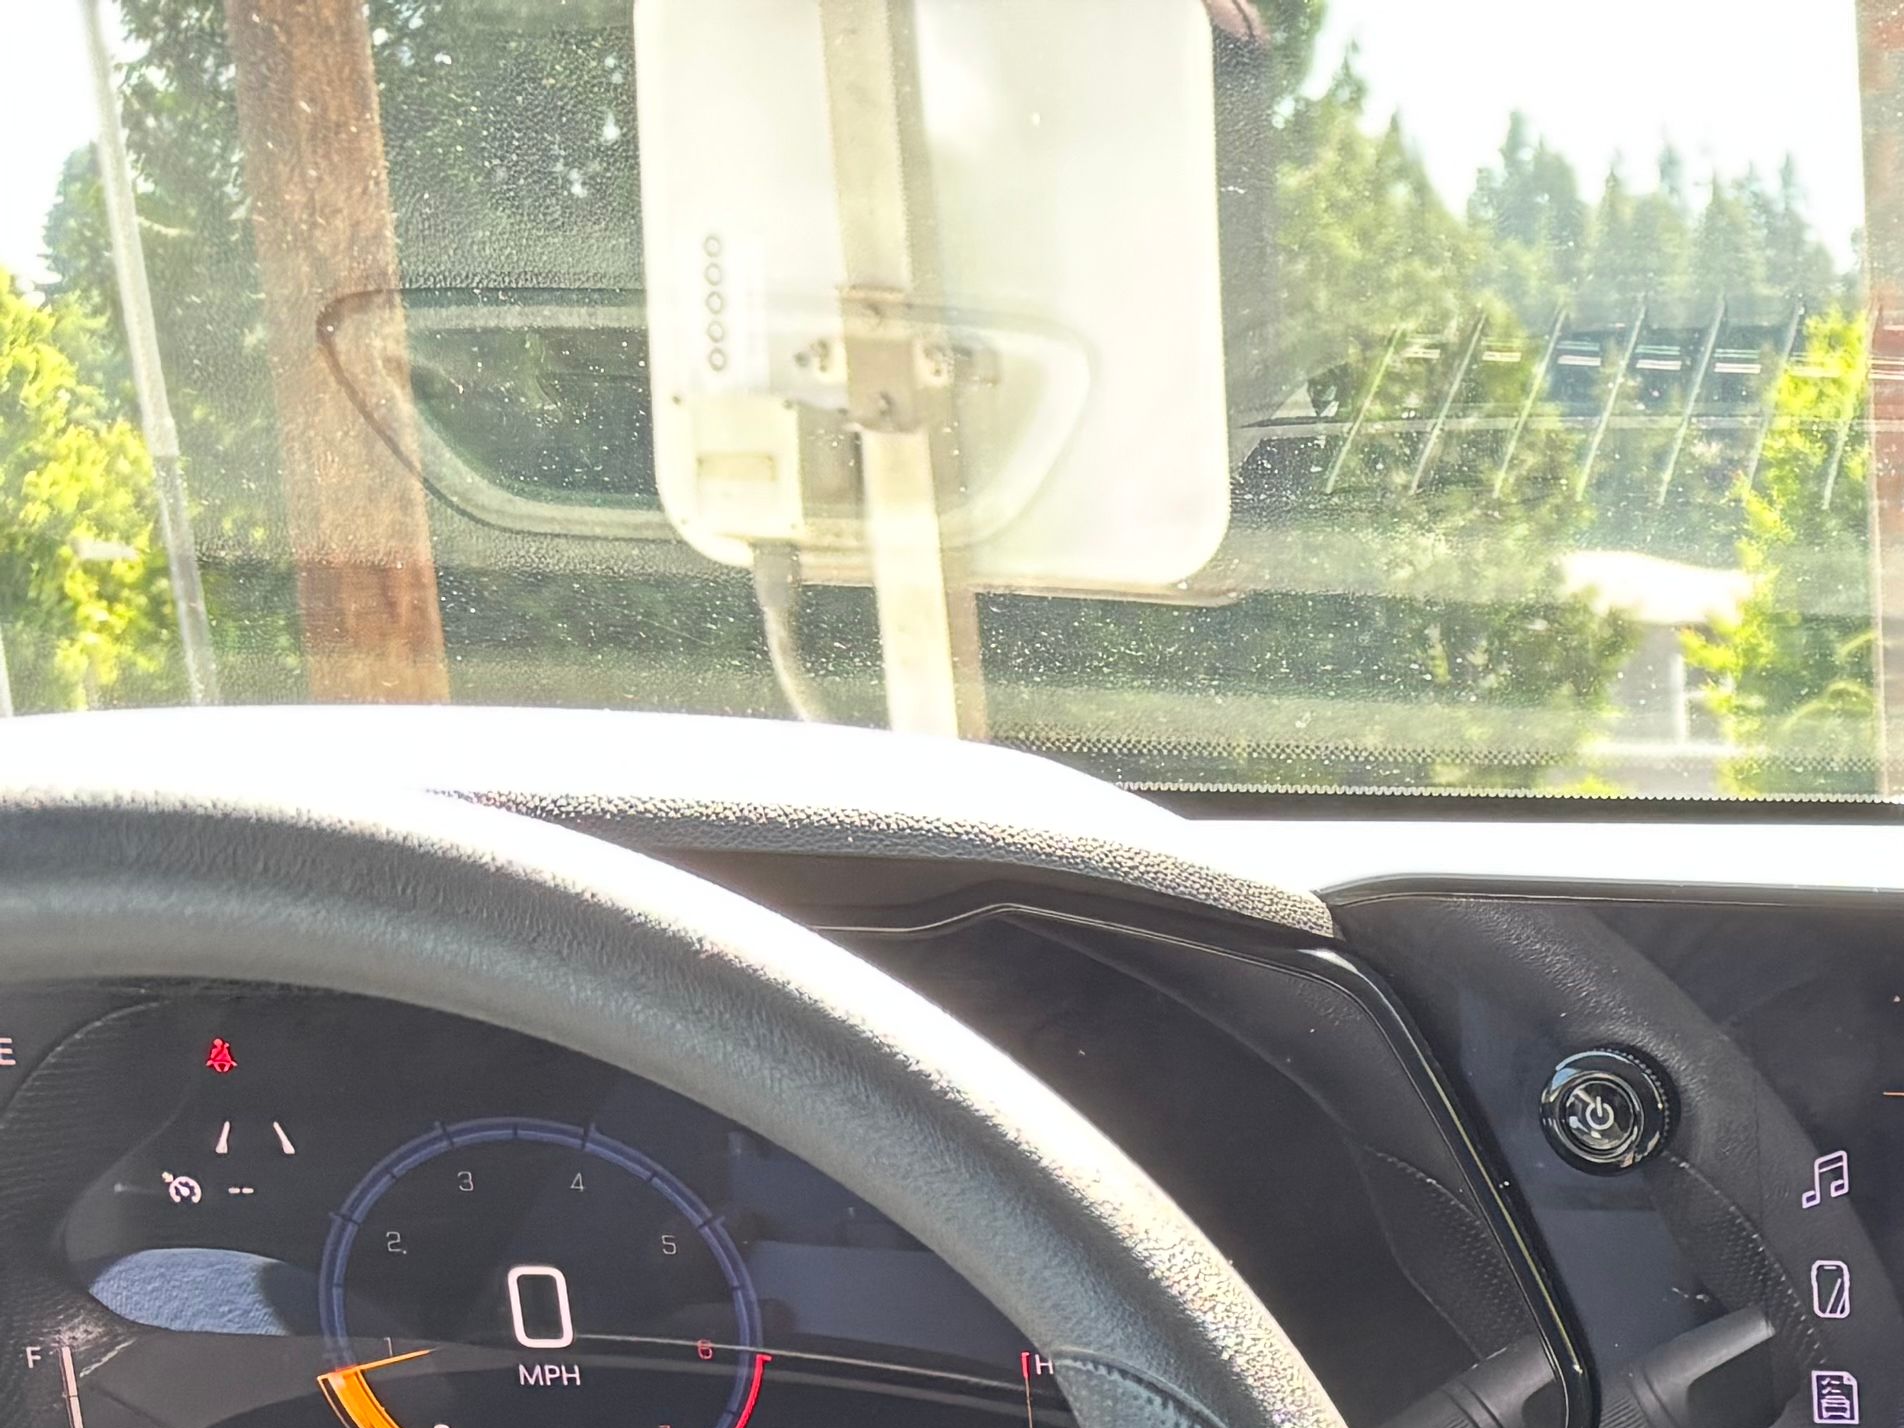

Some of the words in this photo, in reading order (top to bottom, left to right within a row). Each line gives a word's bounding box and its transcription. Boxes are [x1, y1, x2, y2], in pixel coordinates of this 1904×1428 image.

[458, 1171, 474, 1192] 3
[570, 1172, 585, 1192] 4
[386, 1231, 402, 1253] 2
[661, 1235, 677, 1256] 5
[507, 1265, 574, 1349] 0
[26, 1346, 43, 1369] F
[697, 1339, 713, 1360] 6
[518, 1363, 582, 1388] MPH
[1034, 1353, 1055, 1376] H
